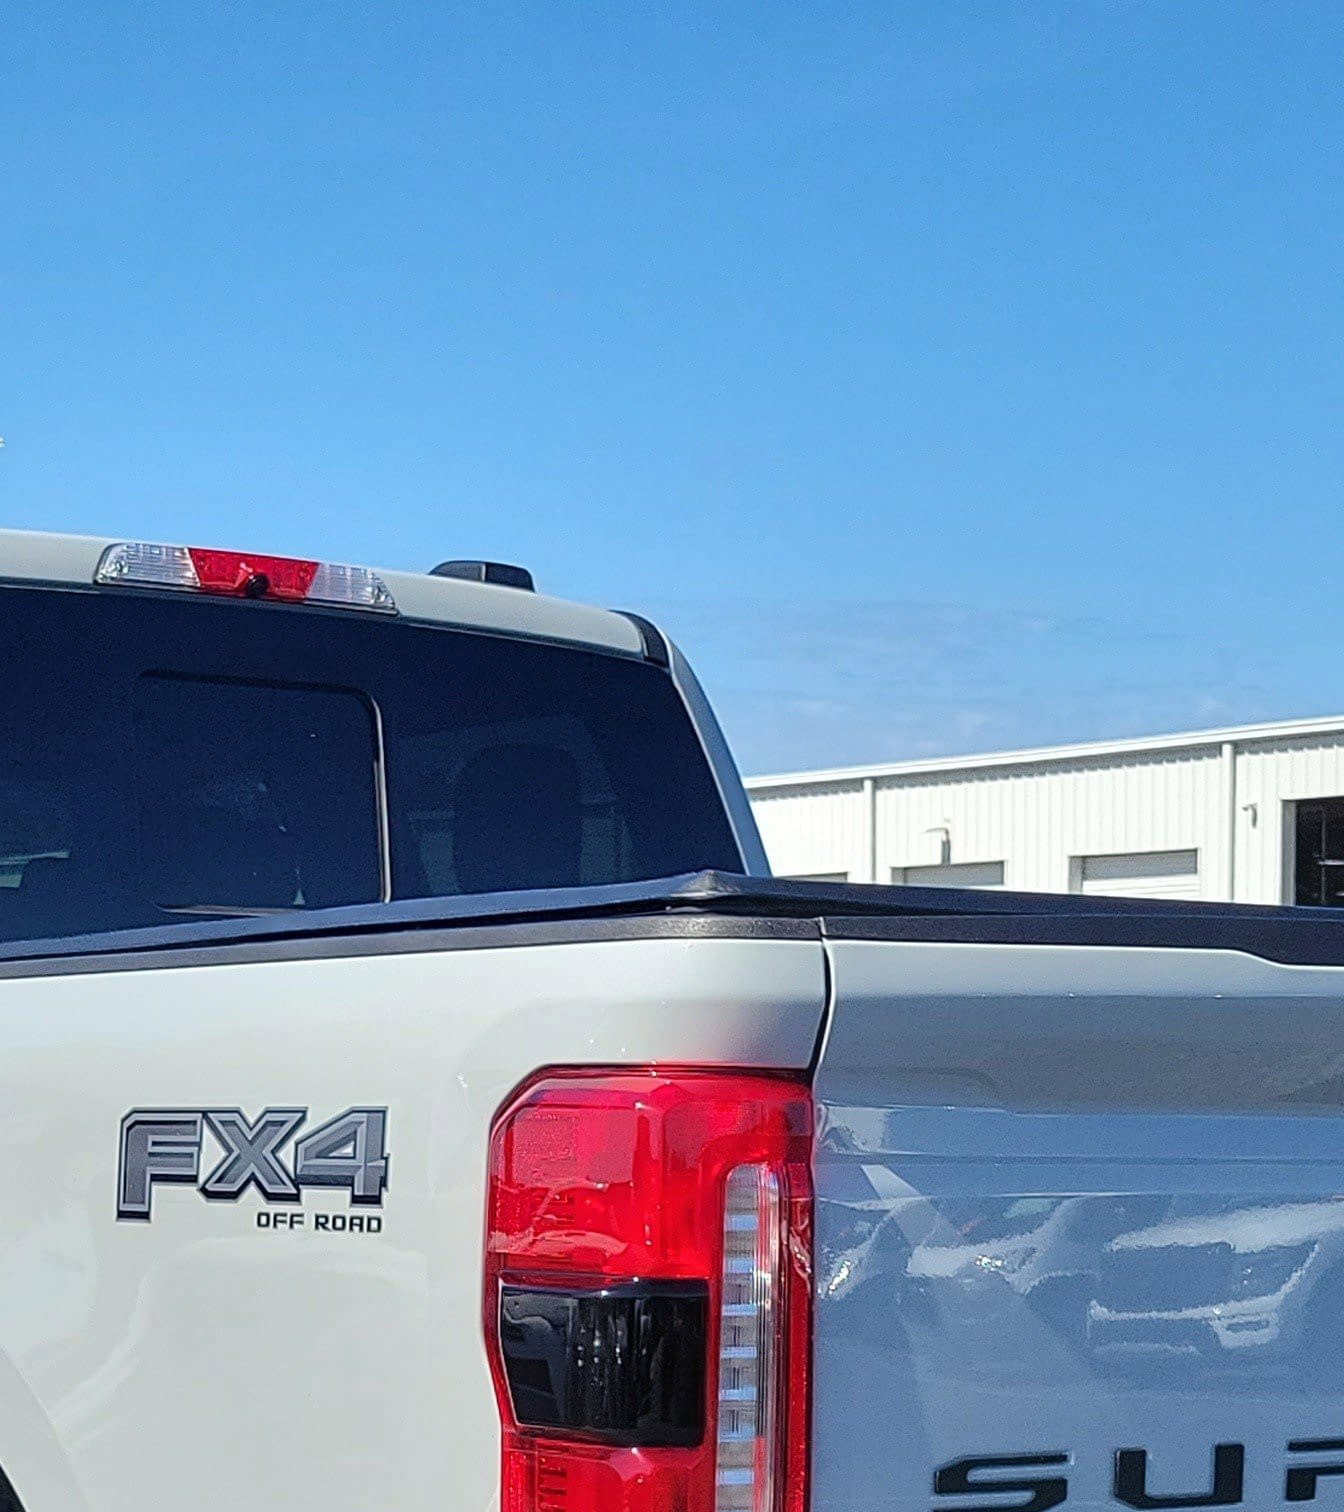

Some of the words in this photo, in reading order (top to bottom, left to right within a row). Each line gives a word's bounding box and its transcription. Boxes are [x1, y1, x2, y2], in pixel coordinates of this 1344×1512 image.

[116, 1106, 389, 1222] FX4
[256, 1211, 304, 1230] OFF
[314, 1213, 382, 1233] ROAD
